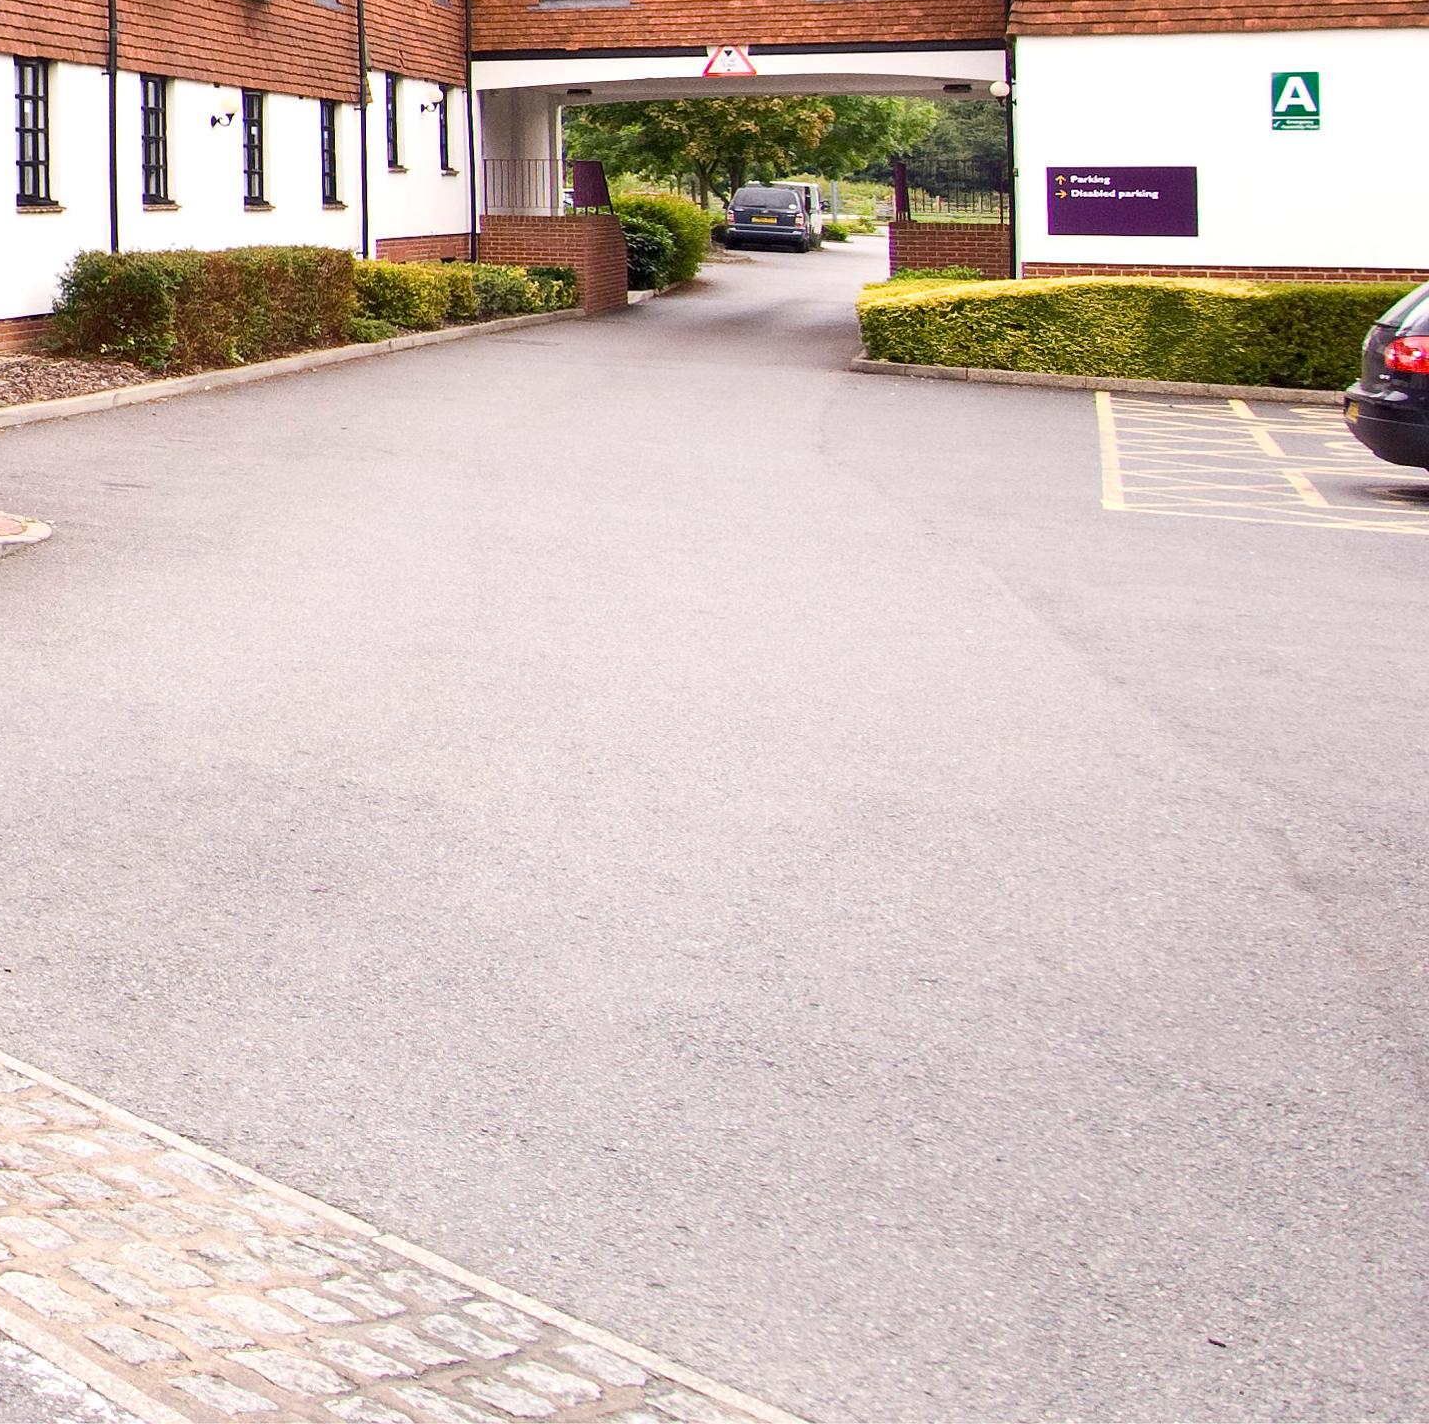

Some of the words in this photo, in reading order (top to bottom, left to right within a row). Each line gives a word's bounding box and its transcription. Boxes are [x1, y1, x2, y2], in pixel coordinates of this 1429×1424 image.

[1274, 76, 1317, 113] A
[1070, 175, 1111, 185] Parking
[1070, 189, 1116, 198] Disabled
[1118, 189, 1159, 199] parking
